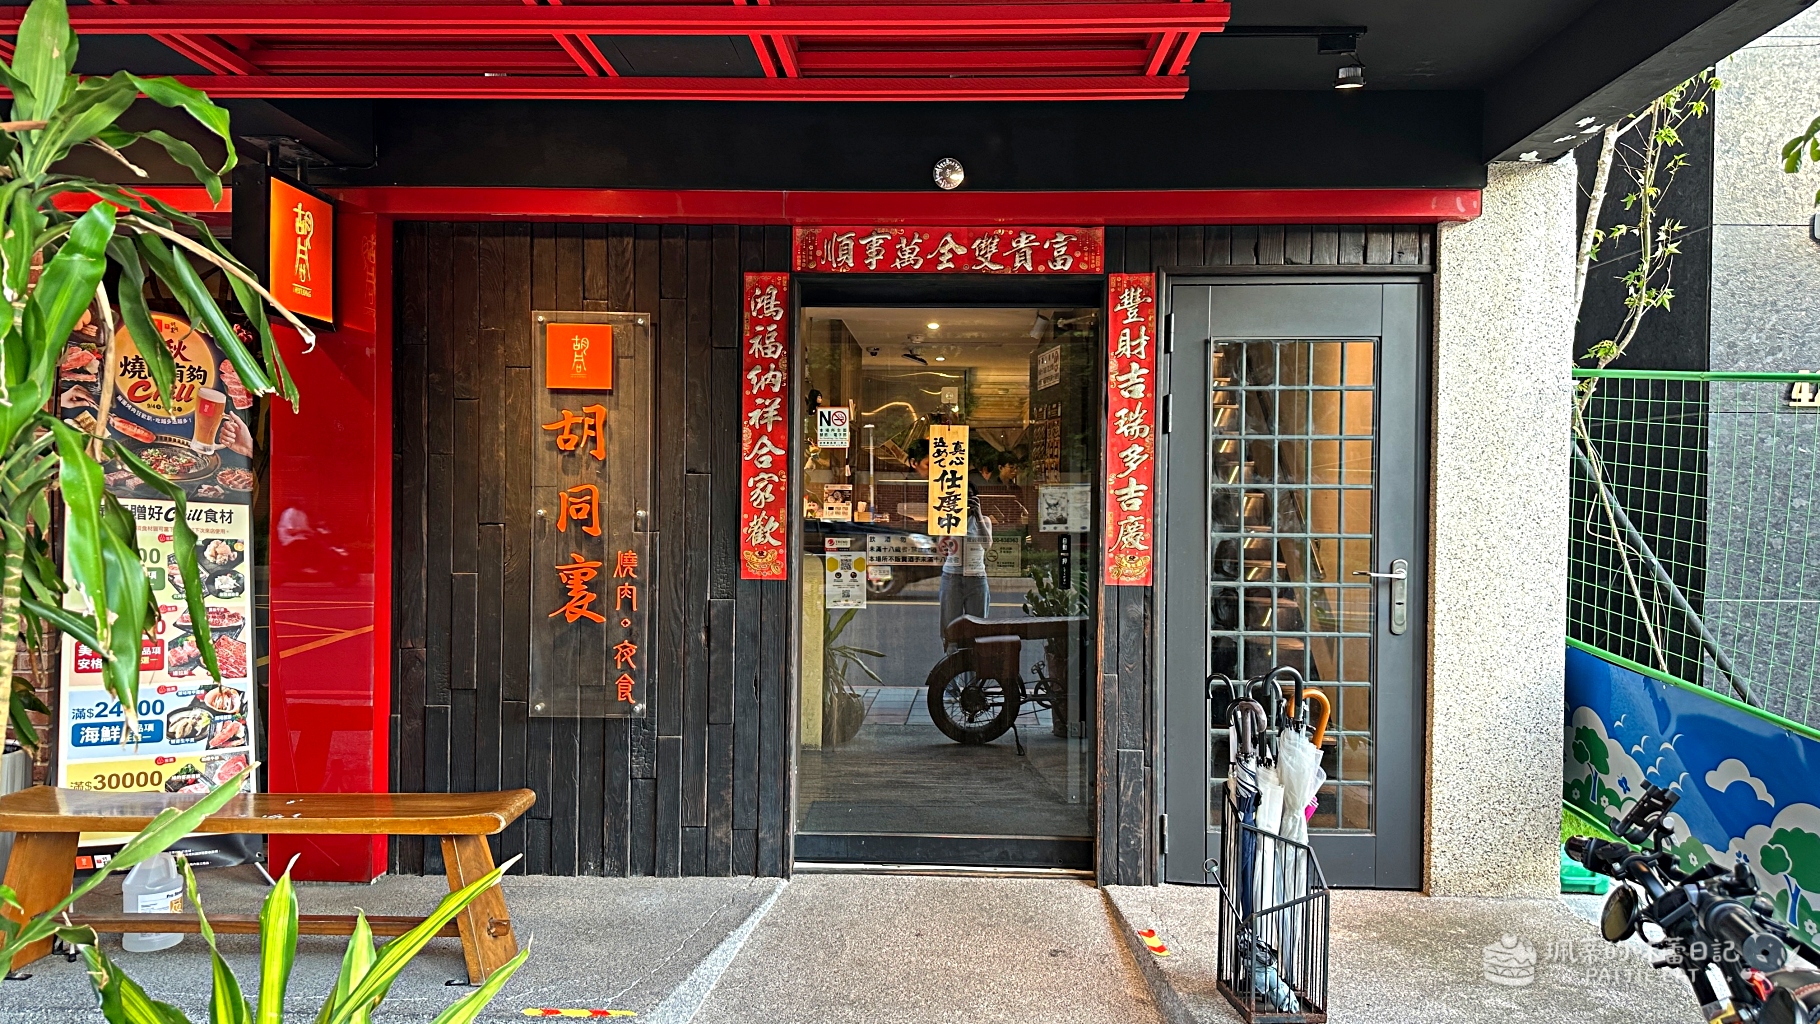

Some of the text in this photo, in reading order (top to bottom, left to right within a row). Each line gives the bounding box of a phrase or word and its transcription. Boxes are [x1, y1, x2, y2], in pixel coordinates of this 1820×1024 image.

[165, 338, 192, 362] 秋
[119, 354, 208, 386] 燒有夠
[1789, 369, 1820, 403] 4
[744, 284, 786, 547] 鴻福納祥合家歡
[1108, 286, 1153, 553] 豐財吉瑞多吉慶
[933, 469, 964, 535] 仕度中
[77, 658, 103, 670] 安格
[72, 699, 165, 720] 滿$2400
[79, 726, 121, 743] 海鮮
[70, 770, 164, 791] 滿$30000
